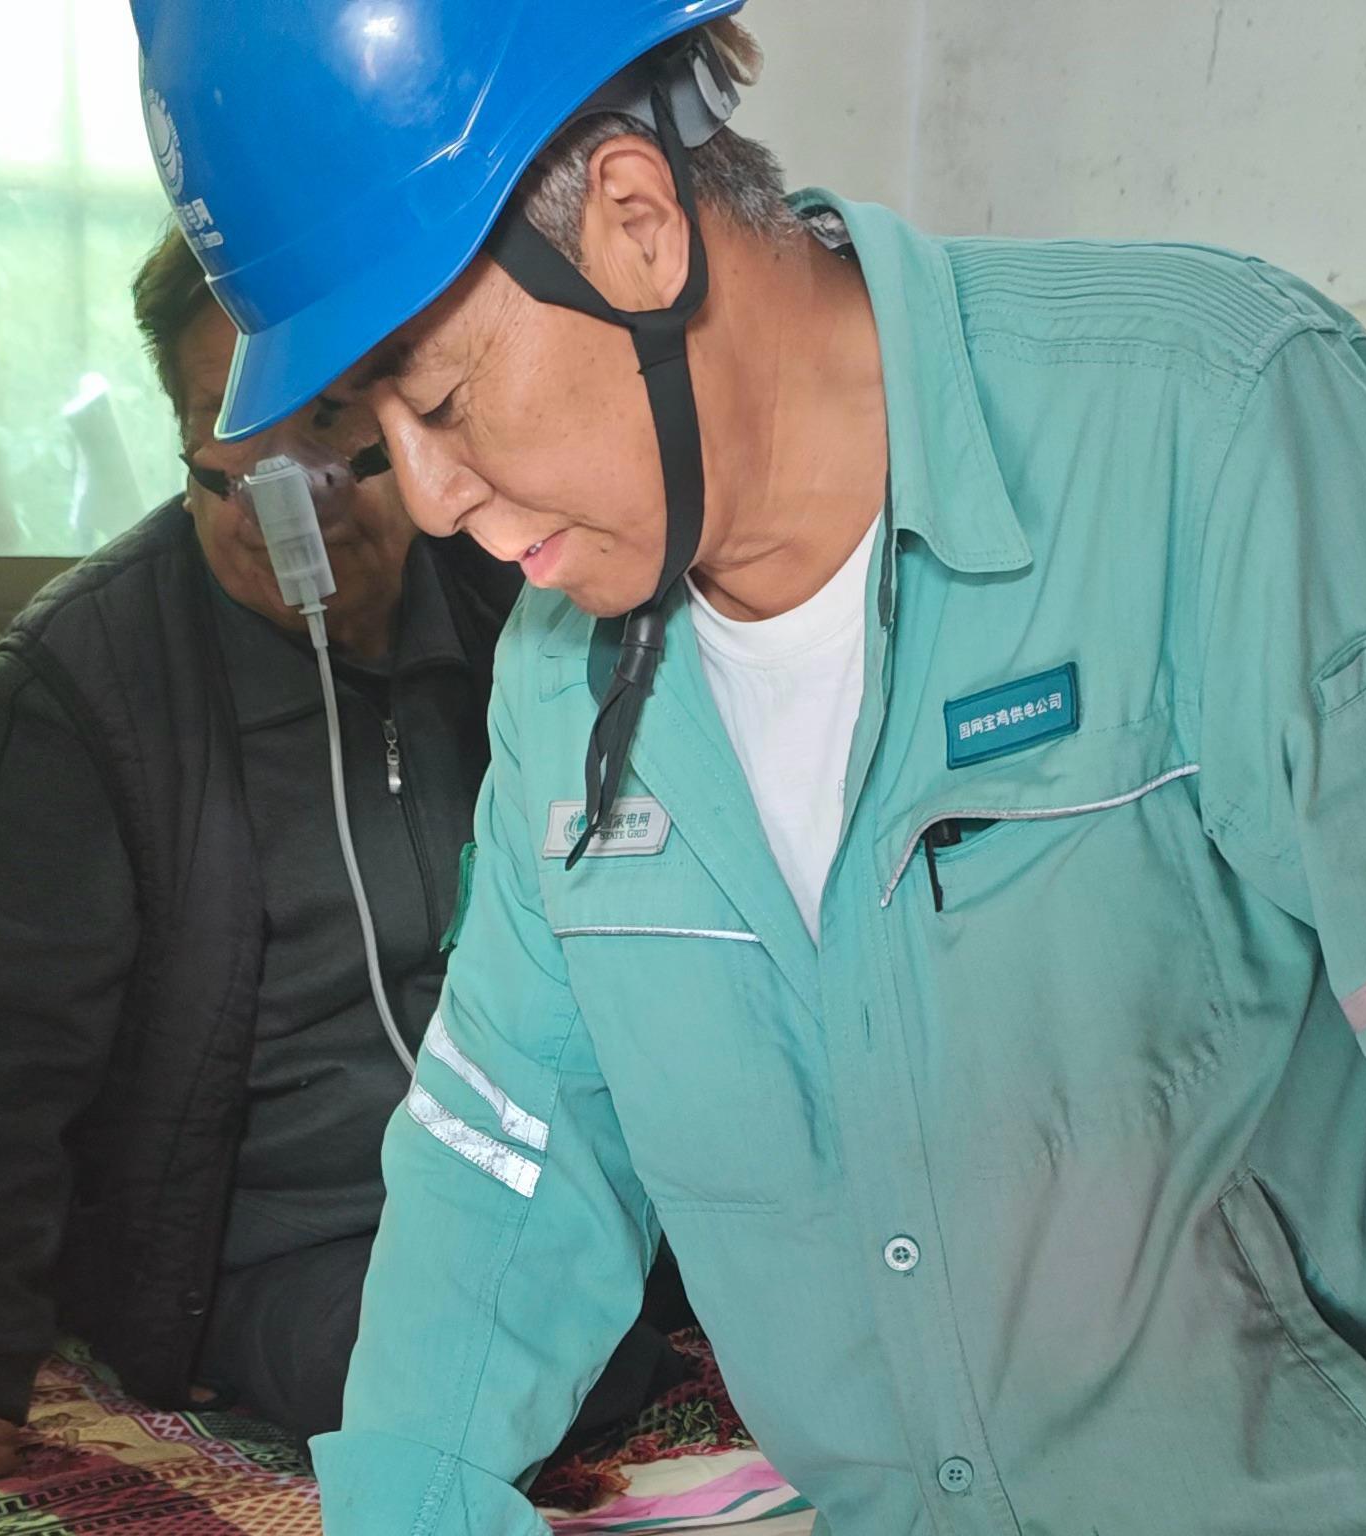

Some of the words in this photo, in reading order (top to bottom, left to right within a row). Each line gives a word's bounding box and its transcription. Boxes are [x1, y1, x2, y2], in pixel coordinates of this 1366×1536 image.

[958, 692, 1062, 740] 国网宝鸡供电公司
[627, 829, 648, 839] GRID
